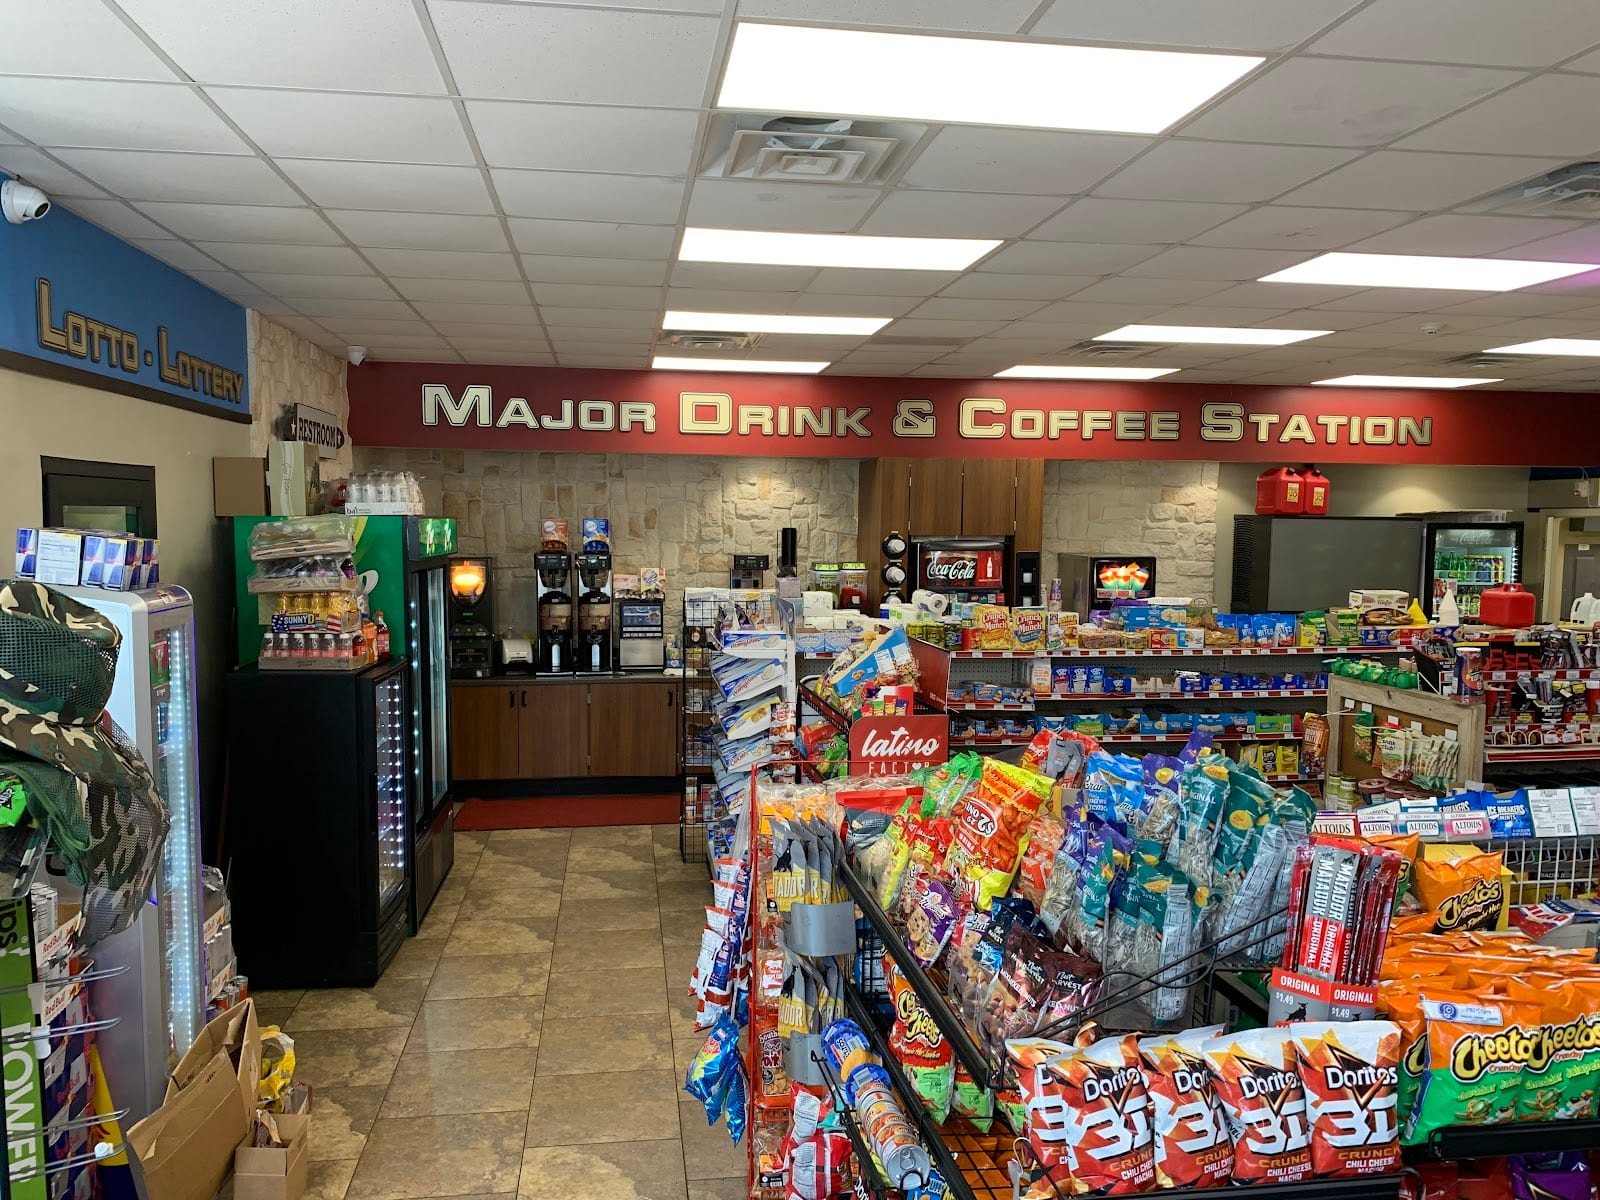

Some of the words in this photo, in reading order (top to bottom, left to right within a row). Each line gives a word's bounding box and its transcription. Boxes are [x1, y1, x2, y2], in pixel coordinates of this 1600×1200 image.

[421, 383, 656, 433] MAJOR
[679, 391, 871, 437] DRINK
[893, 399, 936, 438] &
[958, 397, 1181, 441] COFFEE
[1200, 401, 1432, 445] STATION
[297, 416, 337, 448] RESTROOM
[982, 612, 1007, 622] Crunch
[1017, 613, 1042, 624] Crunch
[985, 621, 1007, 631] Munch
[1019, 622, 1042, 633] Munch
[861, 727, 940, 757] latino
[1487, 806, 1497, 816] ICE
[1498, 804, 1525, 815] BREAKERS
[1313, 822, 1351, 834] ALTOIDS
[1362, 823, 1391, 832] ALTOIDS
[1408, 821, 1437, 831] ALTOIDS
[1455, 820, 1482, 830] ALTOIDS
[1312, 859, 1336, 916] MATADOR
[1328, 864, 1354, 921] MATADOR
[1438, 880, 1501, 928] Cheetos
[1307, 920, 1323, 964] ORIGINAL
[1320, 924, 1338, 973] ORIGINAL
[1280, 975, 1321, 996] ORIGINAL
[1276, 991, 1294, 1006] $1.49
[1334, 989, 1374, 1004] ORIGINAL
[1332, 1007, 1350, 1018] $1.49
[1554, 1051, 1583, 1062] Crunchy
[1488, 1063, 1521, 1073] Crunchy
[1325, 1065, 1398, 1091] Doritos
[1226, 1121, 1241, 1139] EVEL
[1338, 1147, 1401, 1160] CRUNCH
[1204, 1160, 1220, 1174] CHILI
[1259, 1154, 1310, 1168] CRUNC
[1346, 1159, 1367, 1169] CHILI
[1368, 1157, 1395, 1167] CHEESE
[1121, 1166, 1139, 1181] CHILI
[1267, 1168, 1287, 1178] CHILI
[1287, 1163, 1312, 1175] CHEESE
[1134, 1171, 1154, 1185] NACHO
[1278, 1174, 1302, 1183] NACHO
